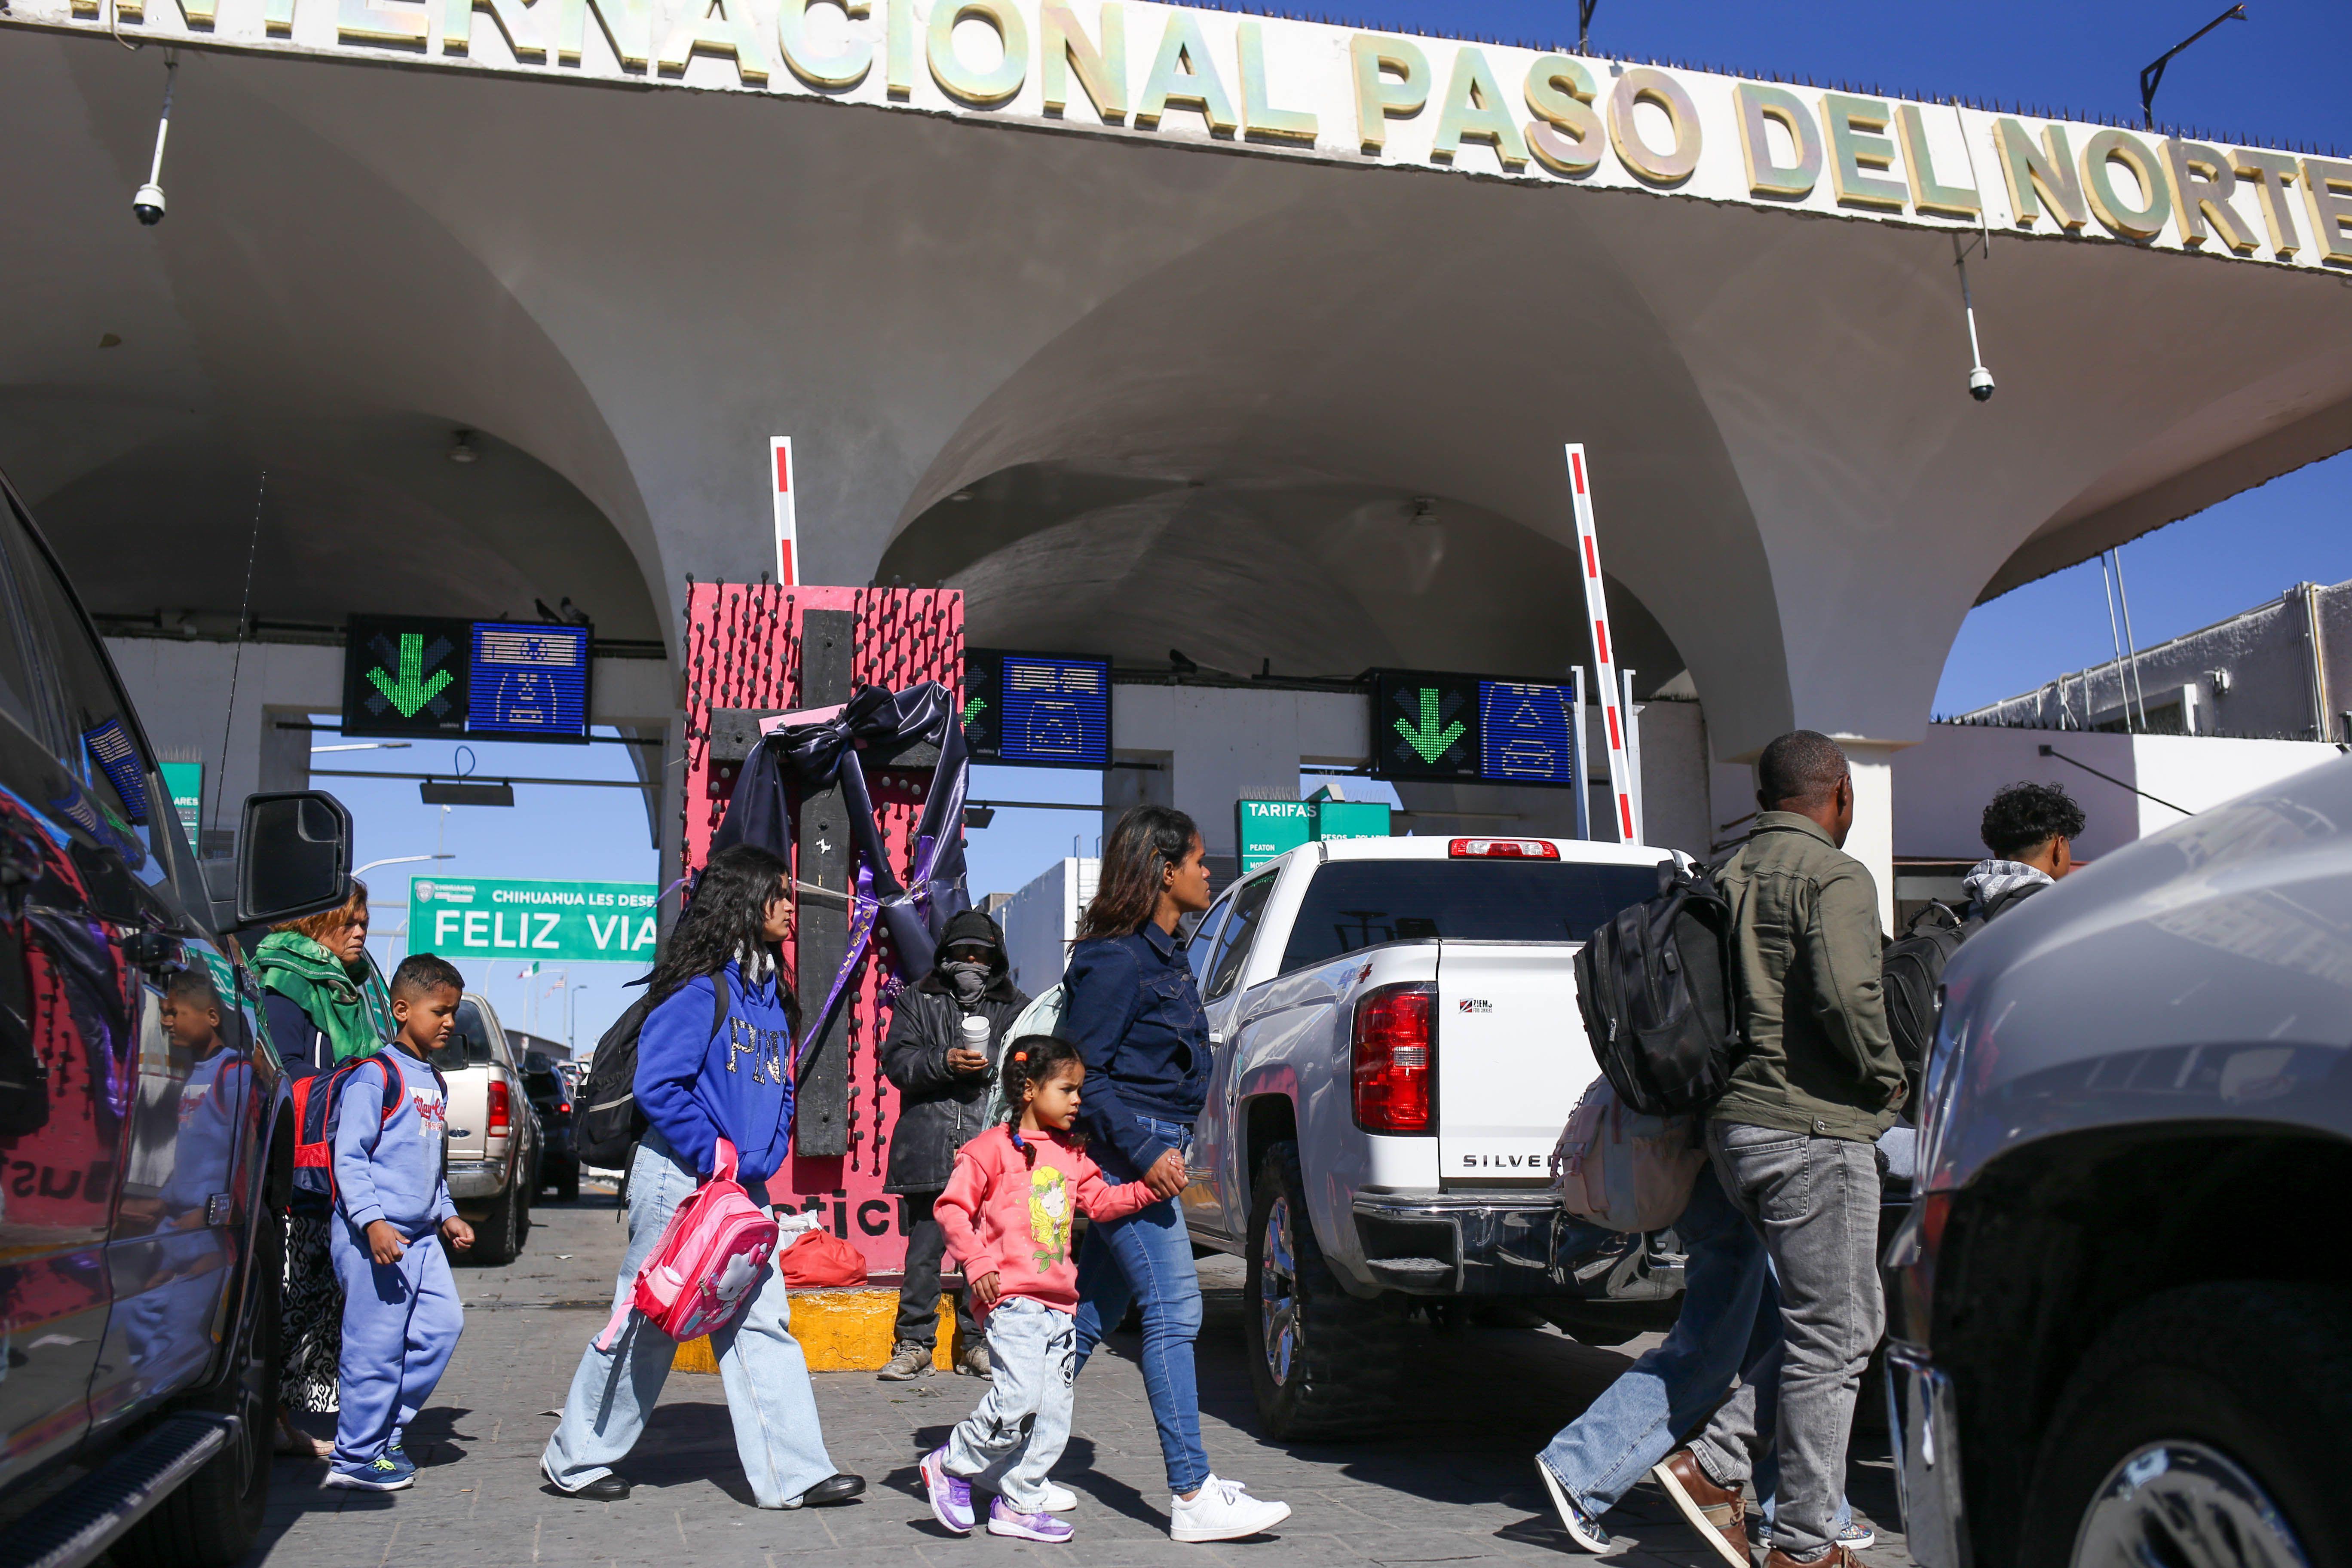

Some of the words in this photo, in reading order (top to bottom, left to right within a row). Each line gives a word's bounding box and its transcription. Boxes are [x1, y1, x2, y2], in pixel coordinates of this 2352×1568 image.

[71, 0, 1318, 144] NACIONAL
[1351, 33, 1702, 184] PASO
[1733, 83, 1982, 218] DEL
[1992, 117, 2352, 264] NORTE
[174, 796, 199, 806] ARES
[1248, 803, 1317, 817] TARIFAS
[492, 889, 585, 906] CHIHUAHUA
[588, 893, 615, 906] LES
[618, 894, 657, 908] DESE
[435, 910, 560, 949] FELIZ
[587, 914, 657, 951] VIA
[850, 920, 870, 947] MAS
[432, 1098, 445, 1121] Co
[1463, 1155, 1562, 1167] SILVER
